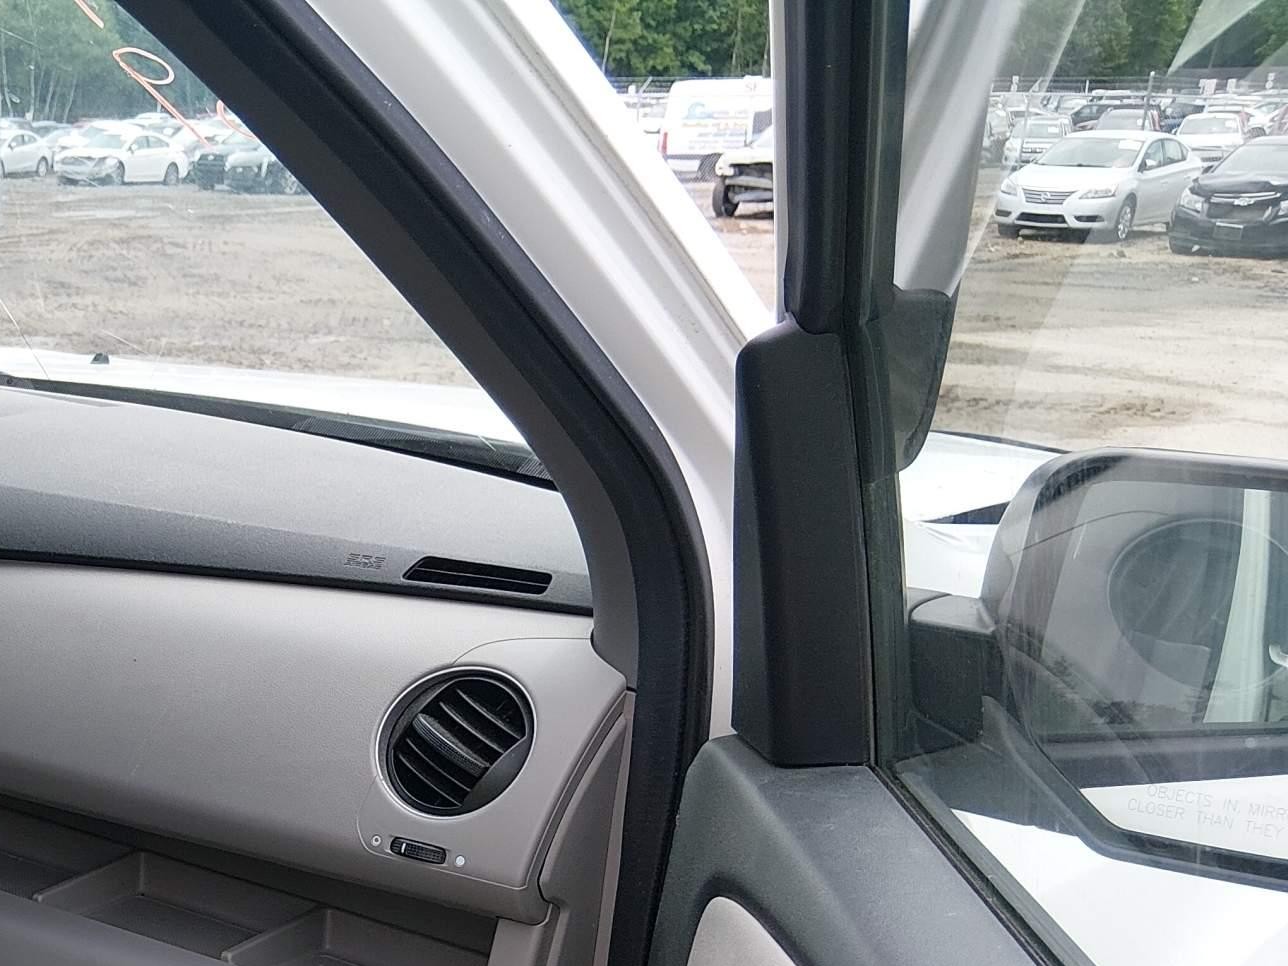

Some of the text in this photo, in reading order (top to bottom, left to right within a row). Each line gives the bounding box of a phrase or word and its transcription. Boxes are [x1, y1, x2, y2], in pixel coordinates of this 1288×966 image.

[1146, 784, 1214, 808] OBJECTS
[1127, 798, 1285, 840] CLOSER THAN THEY
